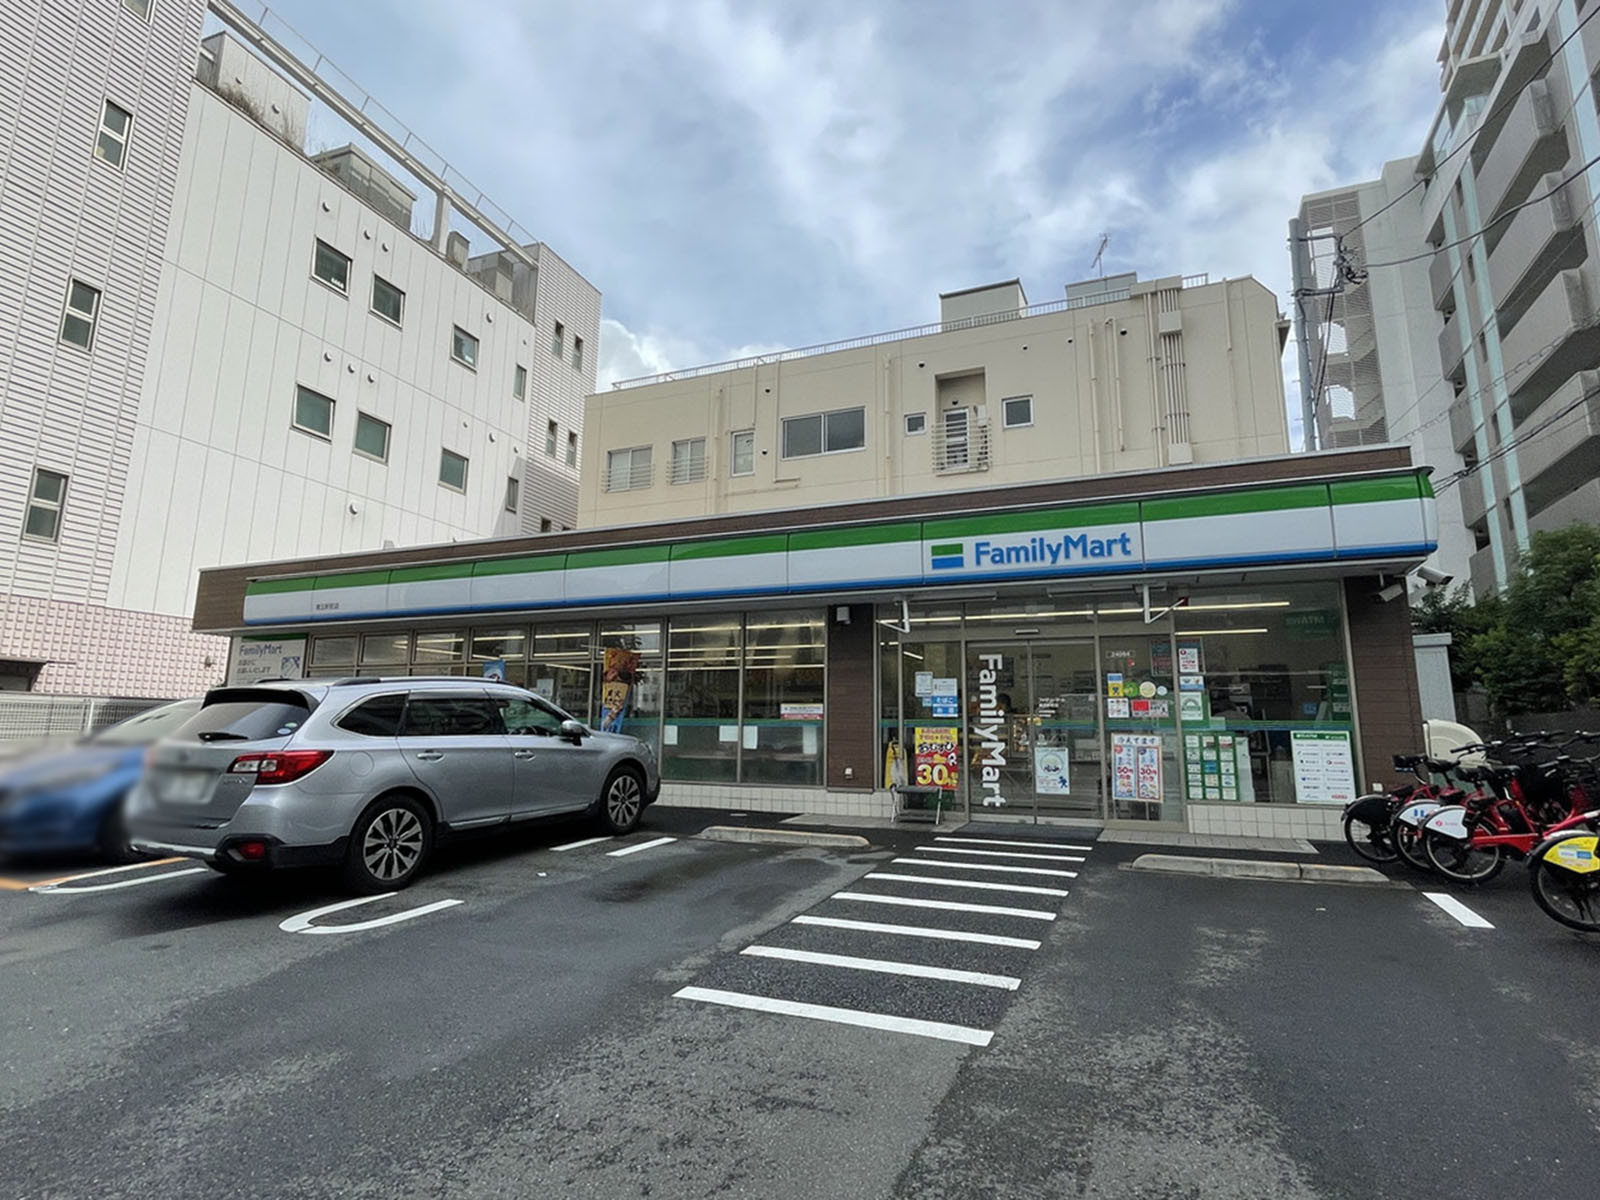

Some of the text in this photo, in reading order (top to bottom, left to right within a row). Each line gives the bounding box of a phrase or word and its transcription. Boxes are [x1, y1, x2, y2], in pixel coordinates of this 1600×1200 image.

[975, 532, 1132, 566] FamilyMart
[239, 643, 283, 657] FamilyMart
[974, 654, 1006, 807] FamilyMart
